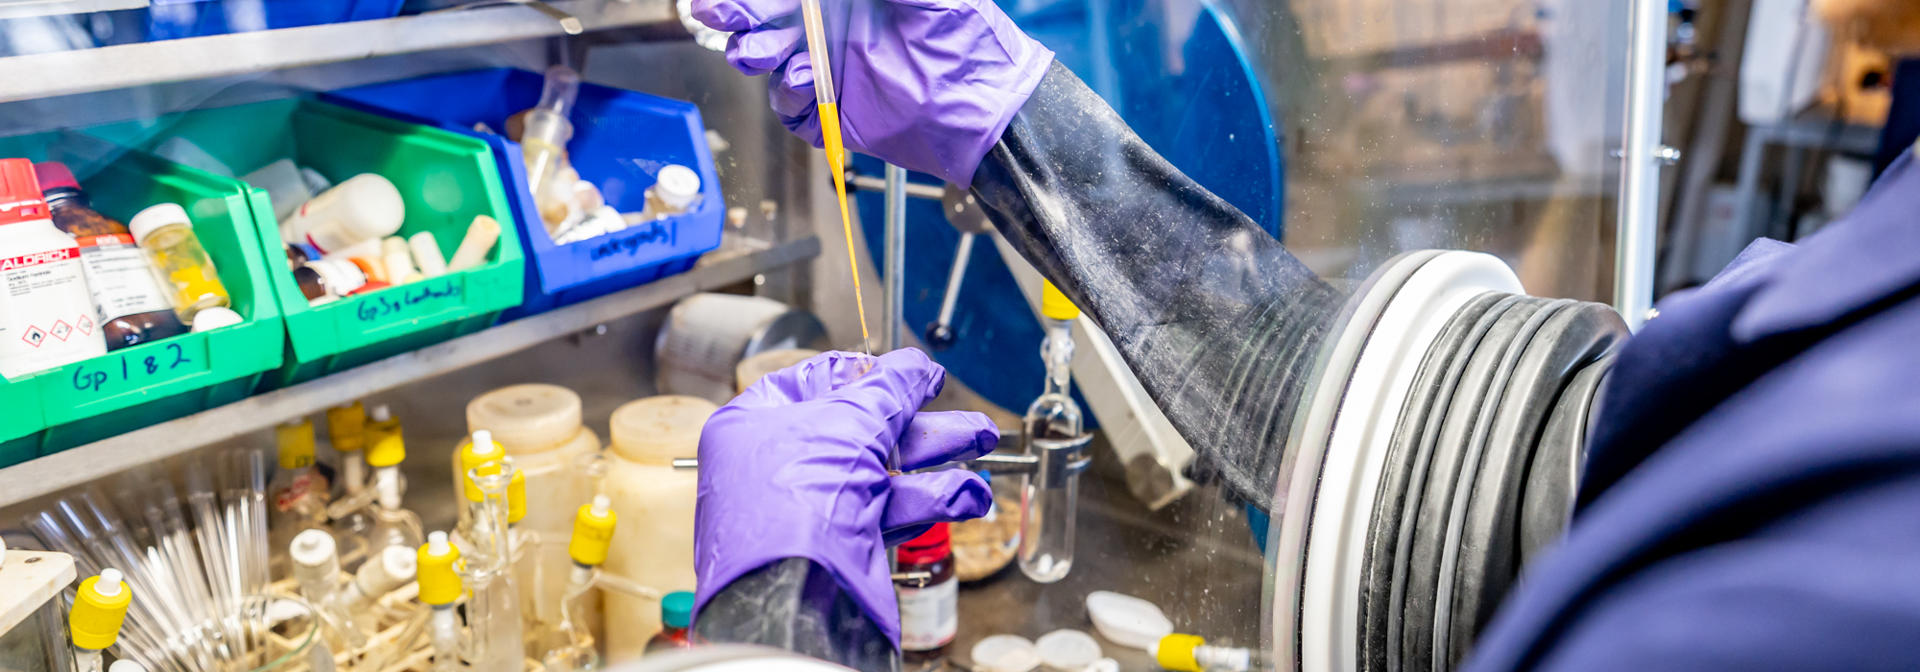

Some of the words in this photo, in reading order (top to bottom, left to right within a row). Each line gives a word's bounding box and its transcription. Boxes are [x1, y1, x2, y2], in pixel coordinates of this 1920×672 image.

[0, 248, 69, 271] ALDRICH
[72, 365, 107, 392] Gp
[166, 343, 191, 369] 2
